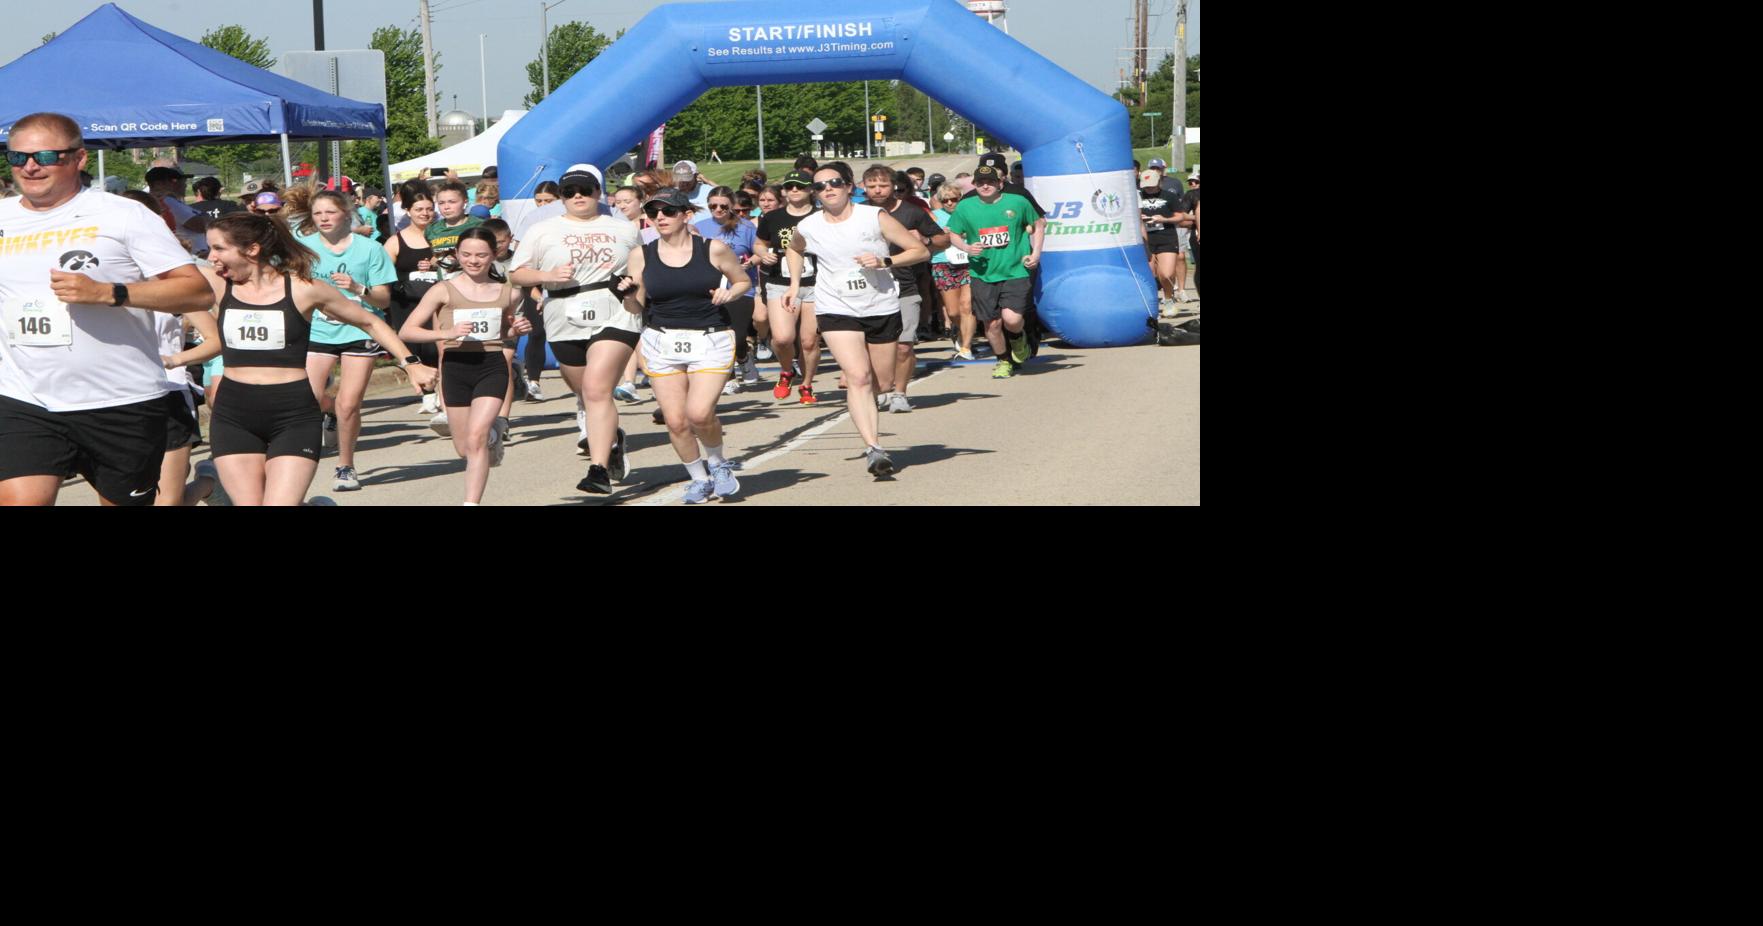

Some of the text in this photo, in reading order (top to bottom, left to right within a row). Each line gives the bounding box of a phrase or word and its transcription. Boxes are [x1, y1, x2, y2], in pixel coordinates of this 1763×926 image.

[729, 22, 873, 42] START/FINISH
[708, 41, 894, 57] See Results at www.J3Timing.com
[91, 123, 117, 132] Scan
[120, 123, 137, 132] QR
[140, 122, 168, 131] Code
[171, 122, 197, 131] Here
[1044, 201, 1083, 219] J3
[1044, 221, 1122, 235] Timing
[981, 232, 1009, 246] 2782
[570, 247, 613, 264] RAYS
[846, 278, 867, 290] 115
[581, 309, 596, 320] 10
[18, 316, 51, 335] 146
[471, 320, 489, 334] 83
[237, 325, 269, 342] 149
[674, 341, 692, 353] 33
